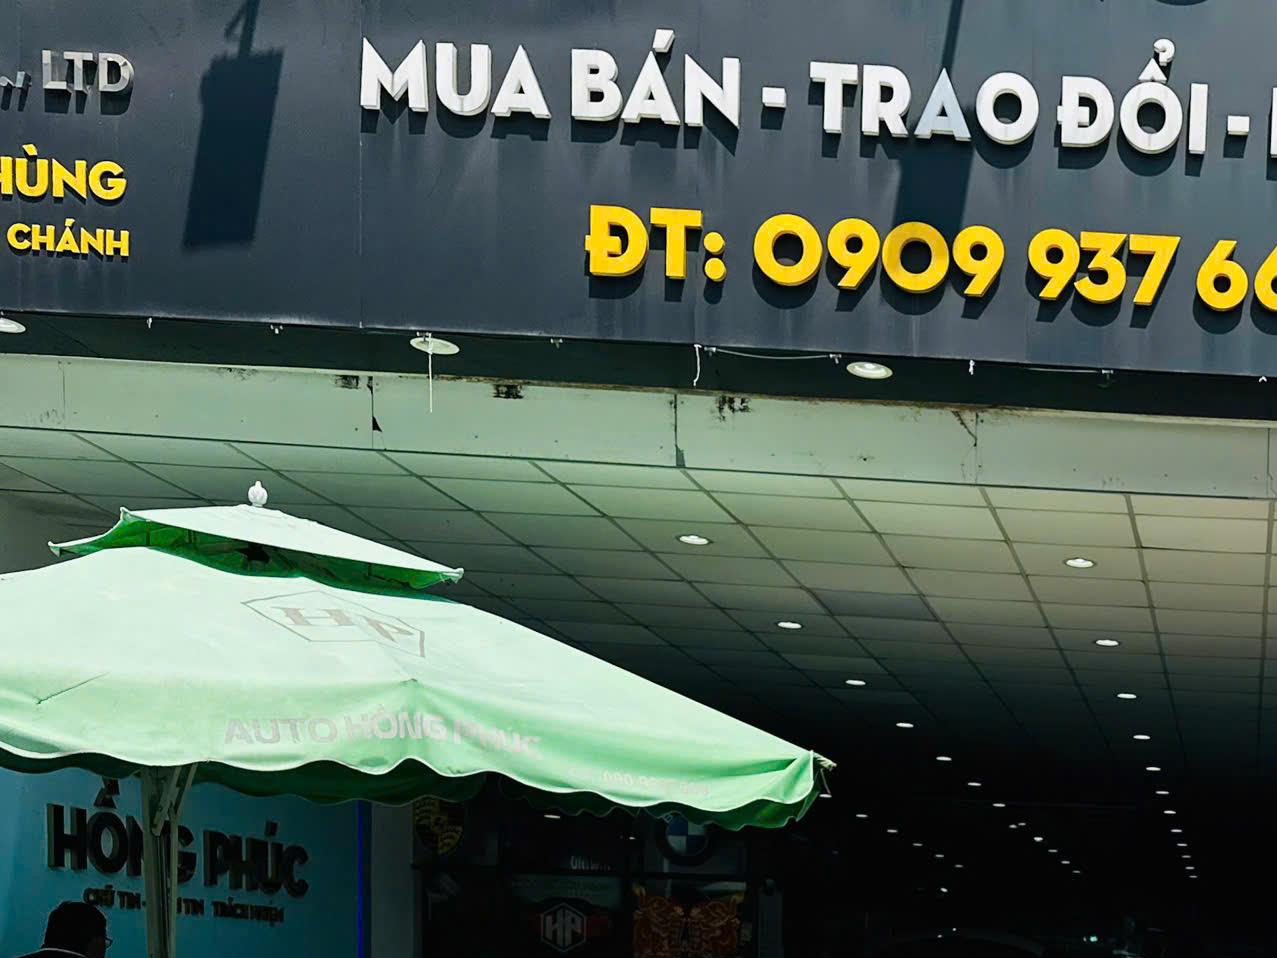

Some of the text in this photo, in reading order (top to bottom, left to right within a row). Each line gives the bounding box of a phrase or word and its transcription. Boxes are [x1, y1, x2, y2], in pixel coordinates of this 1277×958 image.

[41, 50, 134, 94] LTD
[360, 37, 552, 119] MUA
[571, 29, 740, 129] BÁN
[810, 61, 1039, 146] TRAO
[1057, 38, 1208, 154] ĐỔI
[7, 218, 129, 256] CHÁNH
[584, 204, 727, 283] ĐT:
[754, 213, 1005, 299] 0909
[1027, 227, 1181, 306] 937
[224, 717, 338, 744] AUTO
[204, 818, 308, 897] PHÚC
